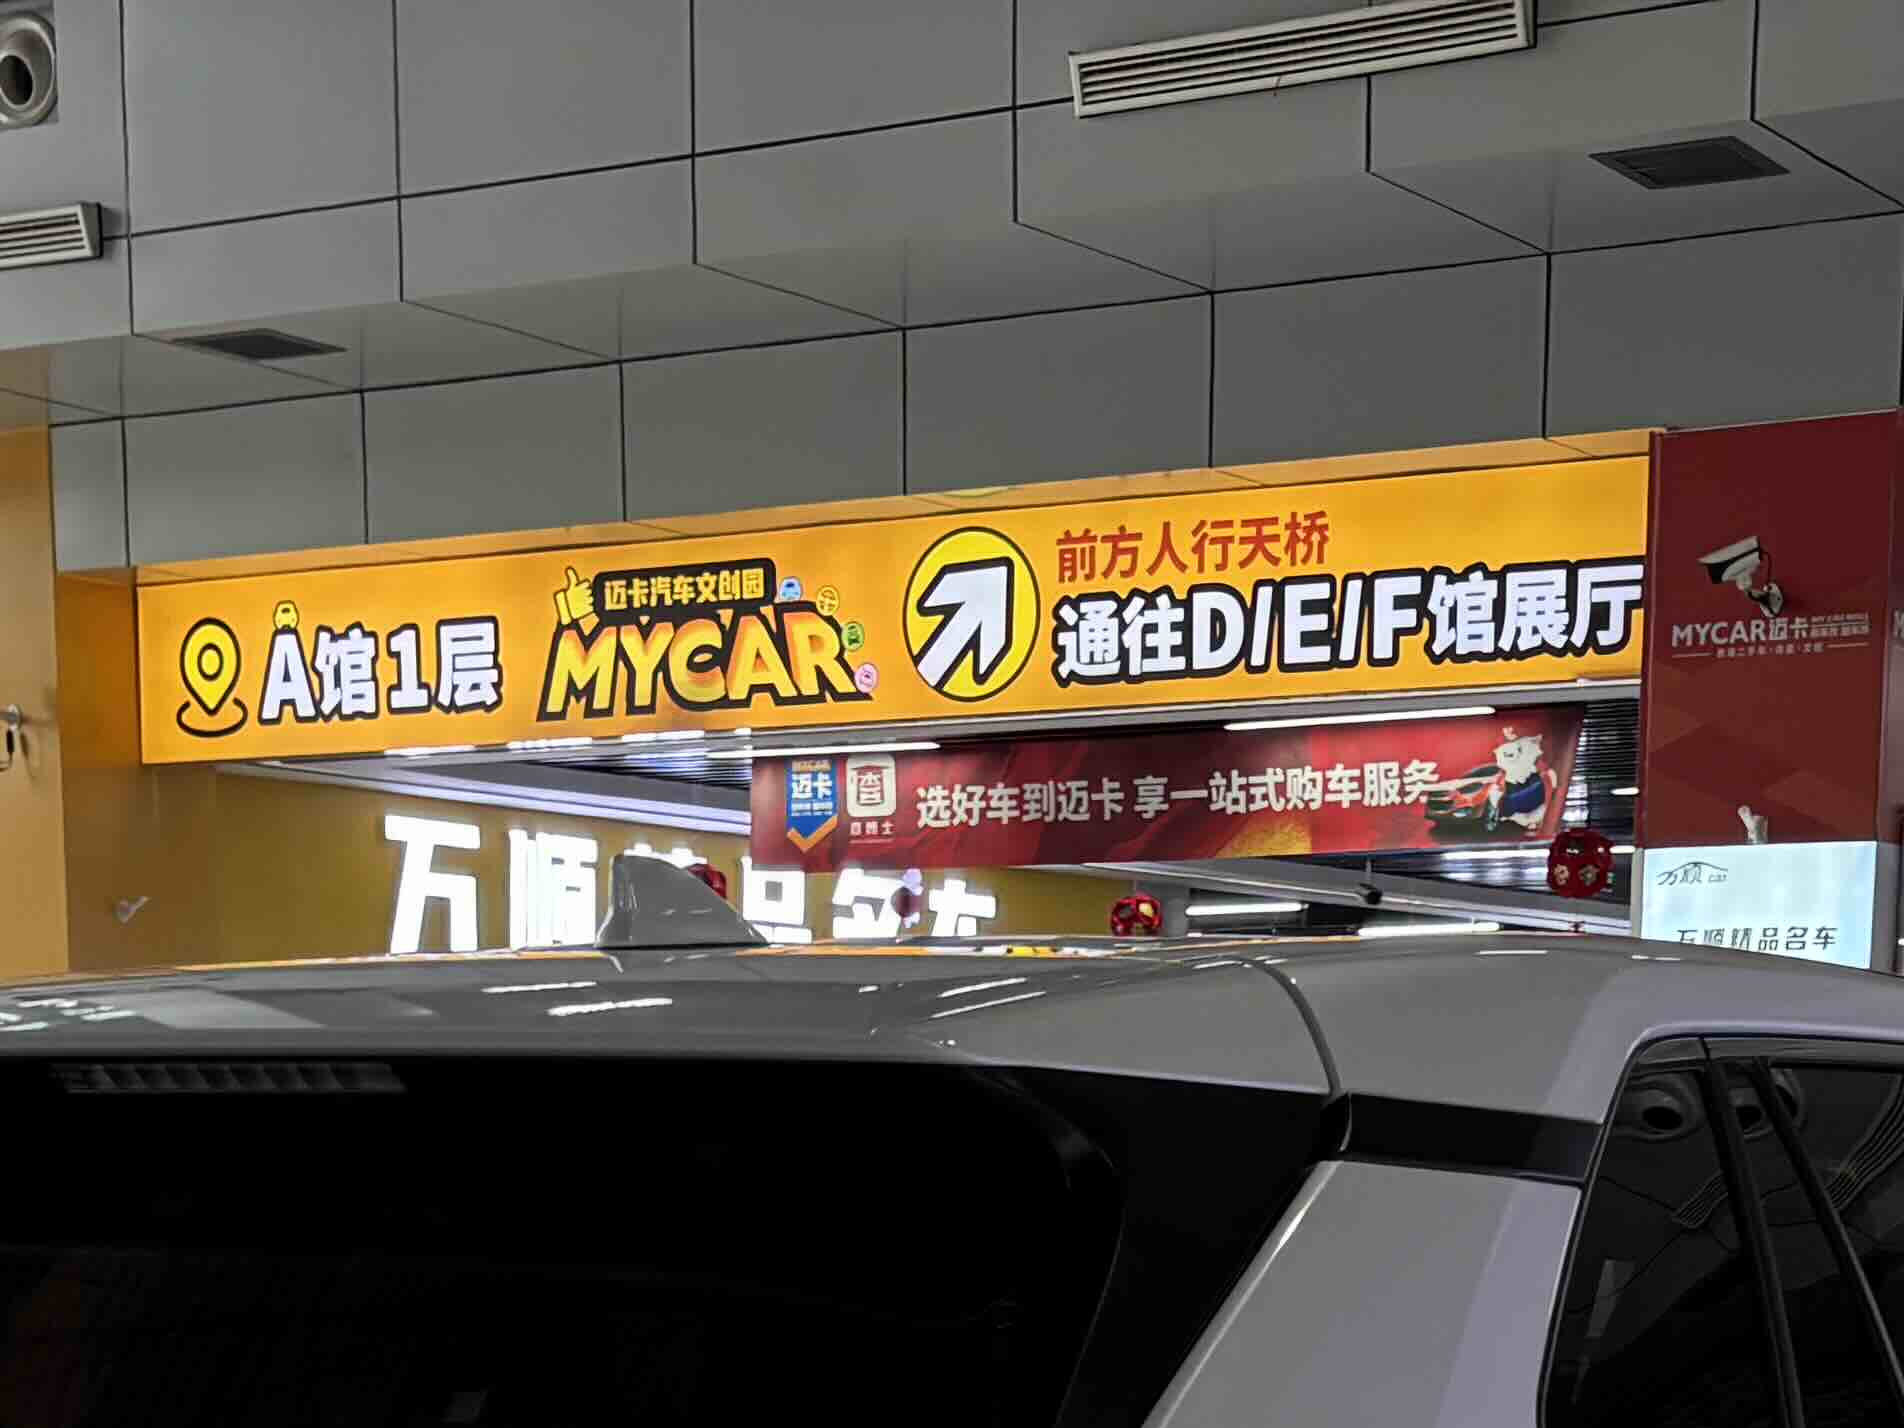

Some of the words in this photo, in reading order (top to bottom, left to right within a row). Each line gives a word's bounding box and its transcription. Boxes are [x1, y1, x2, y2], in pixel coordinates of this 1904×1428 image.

[603, 567, 765, 609] 迈卡汽车文创园
[1057, 511, 1330, 584] 前方人行天桥
[261, 620, 500, 722] A馆1层
[544, 617, 854, 716] MYCAR
[1056, 564, 1644, 681] 通往D/E/F馆展厅
[916, 778, 1126, 830] 选好车到迈卡
[1132, 759, 1440, 822] 享一站式购车服务
[383, 813, 996, 954] 万顺品
